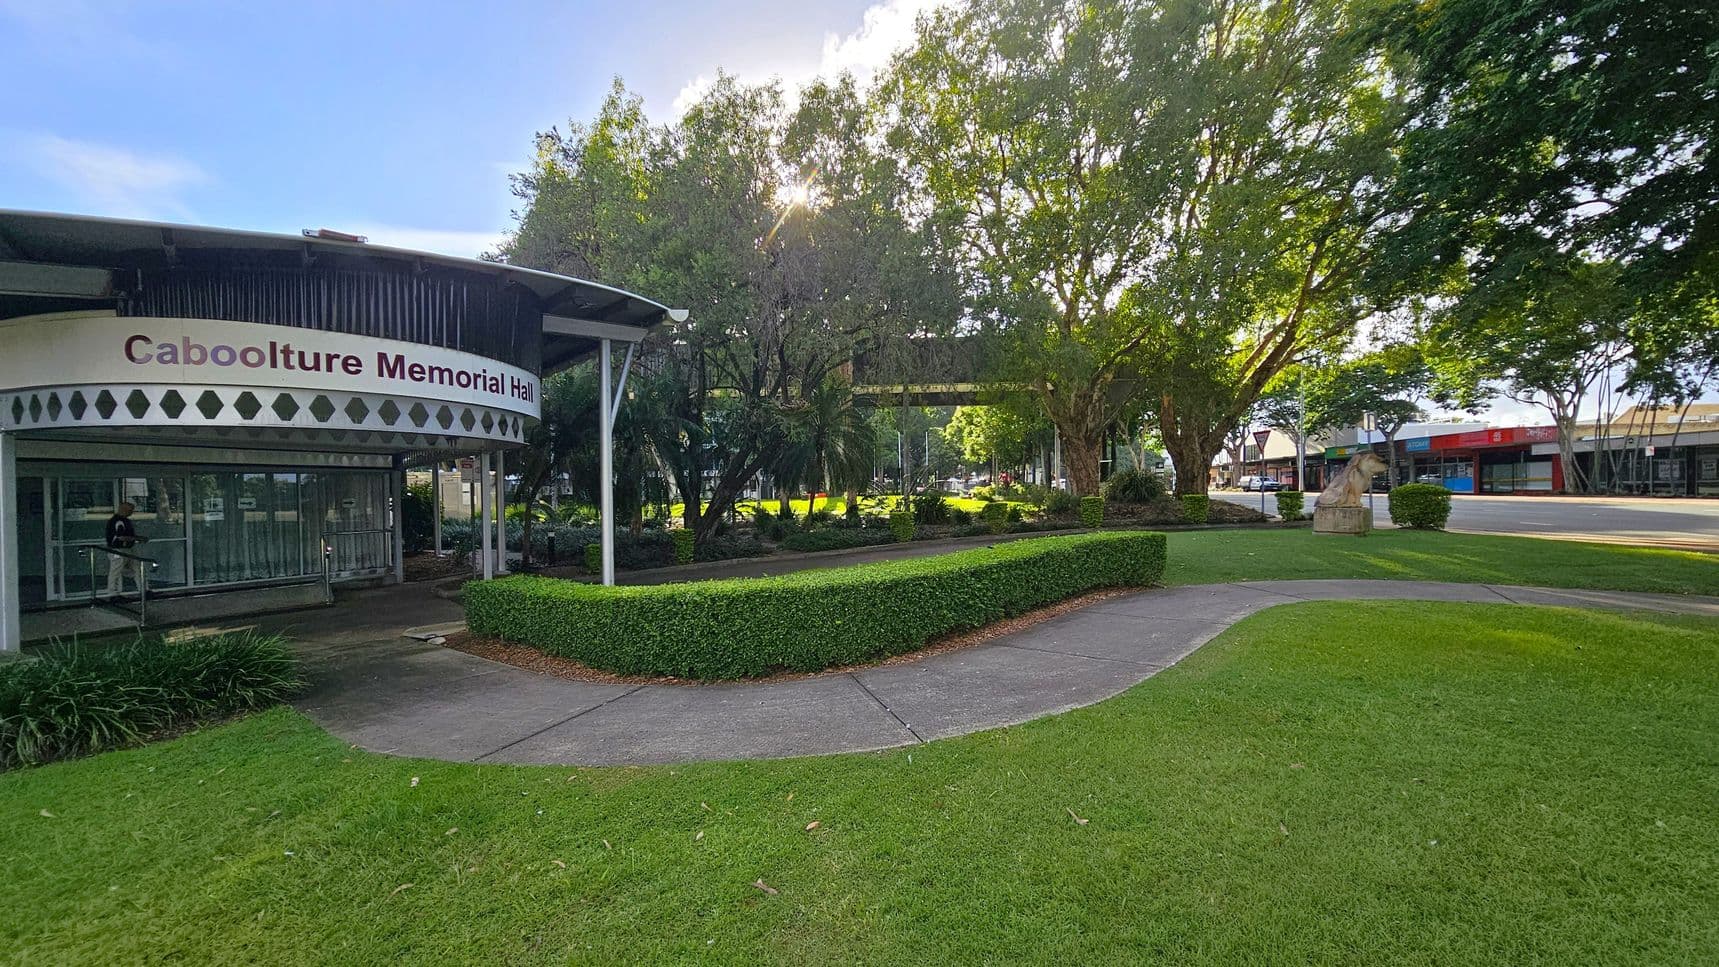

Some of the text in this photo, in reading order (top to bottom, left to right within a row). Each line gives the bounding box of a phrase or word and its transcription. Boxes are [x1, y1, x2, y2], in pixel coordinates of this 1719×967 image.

[124, 334, 534, 403] Caboolture Memorial Hall
